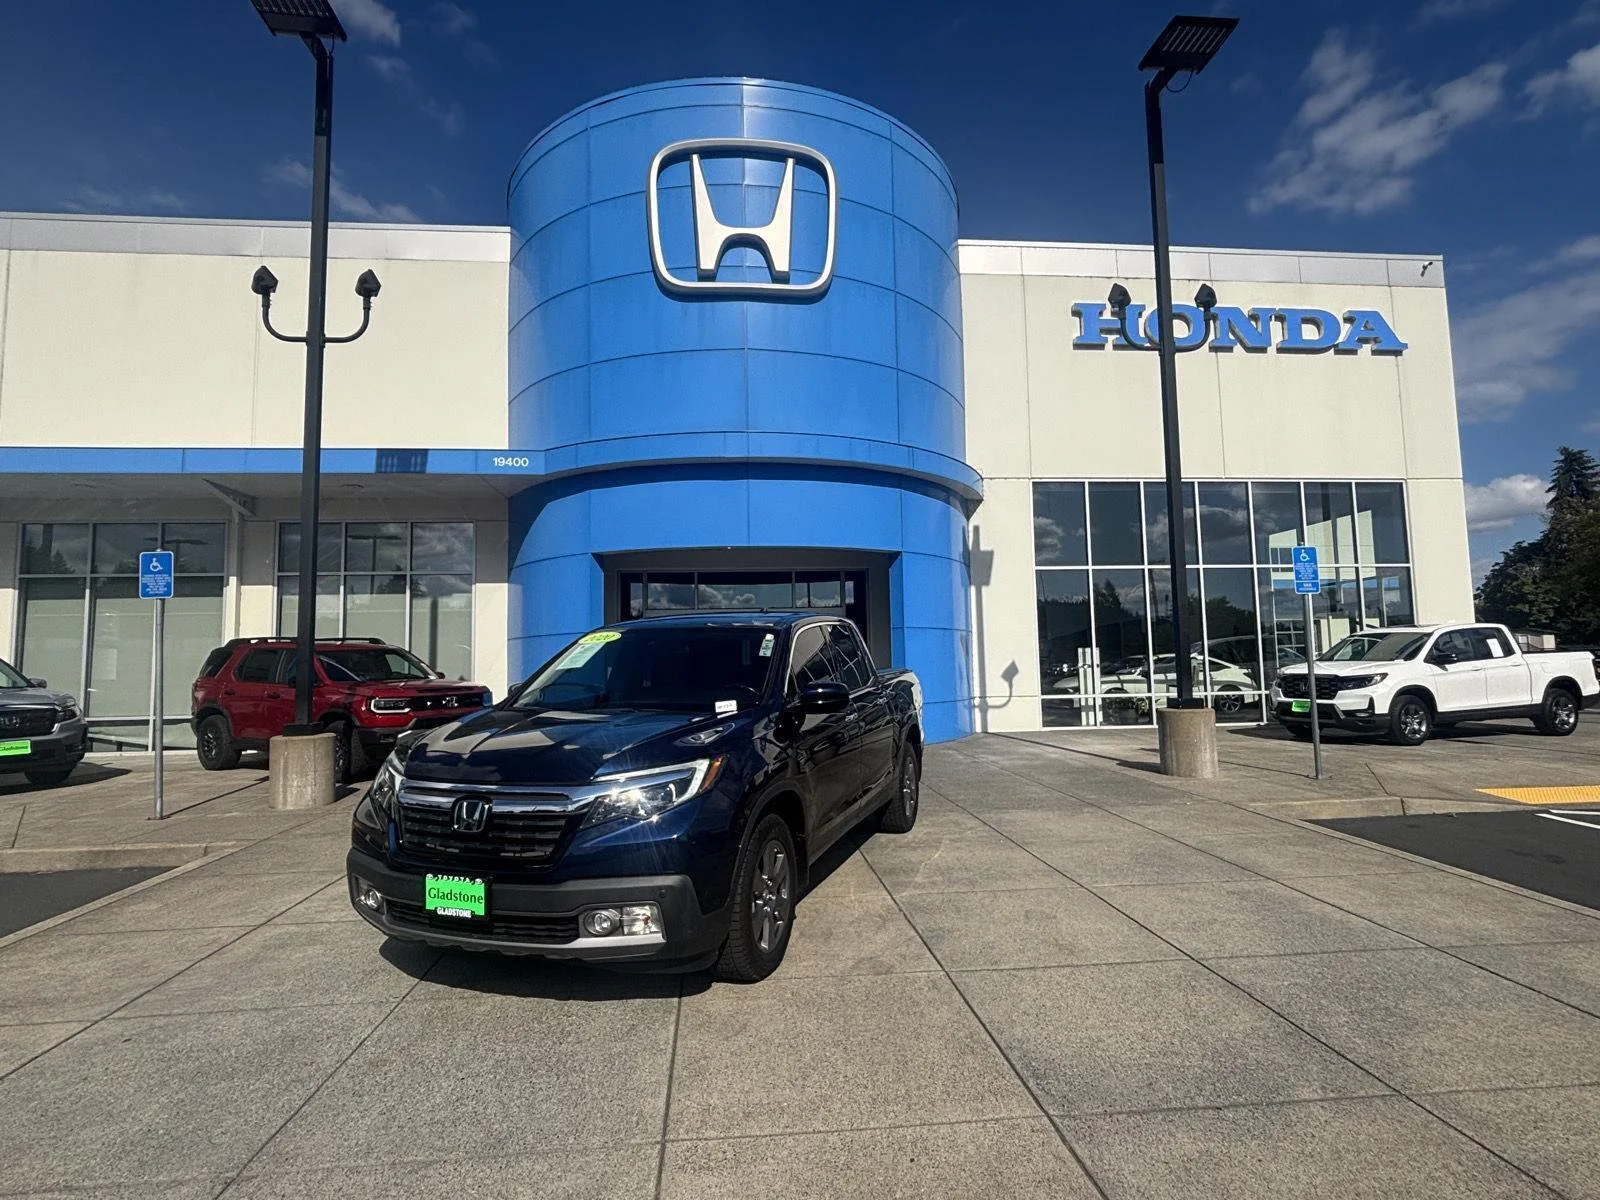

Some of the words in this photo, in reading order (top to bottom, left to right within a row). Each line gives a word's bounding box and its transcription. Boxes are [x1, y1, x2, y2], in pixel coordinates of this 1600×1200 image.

[1071, 302, 1408, 355] HONDA
[493, 457, 529, 467] 19400
[428, 887, 484, 904] Gladstone
[436, 906, 472, 918] GLADSTONE
